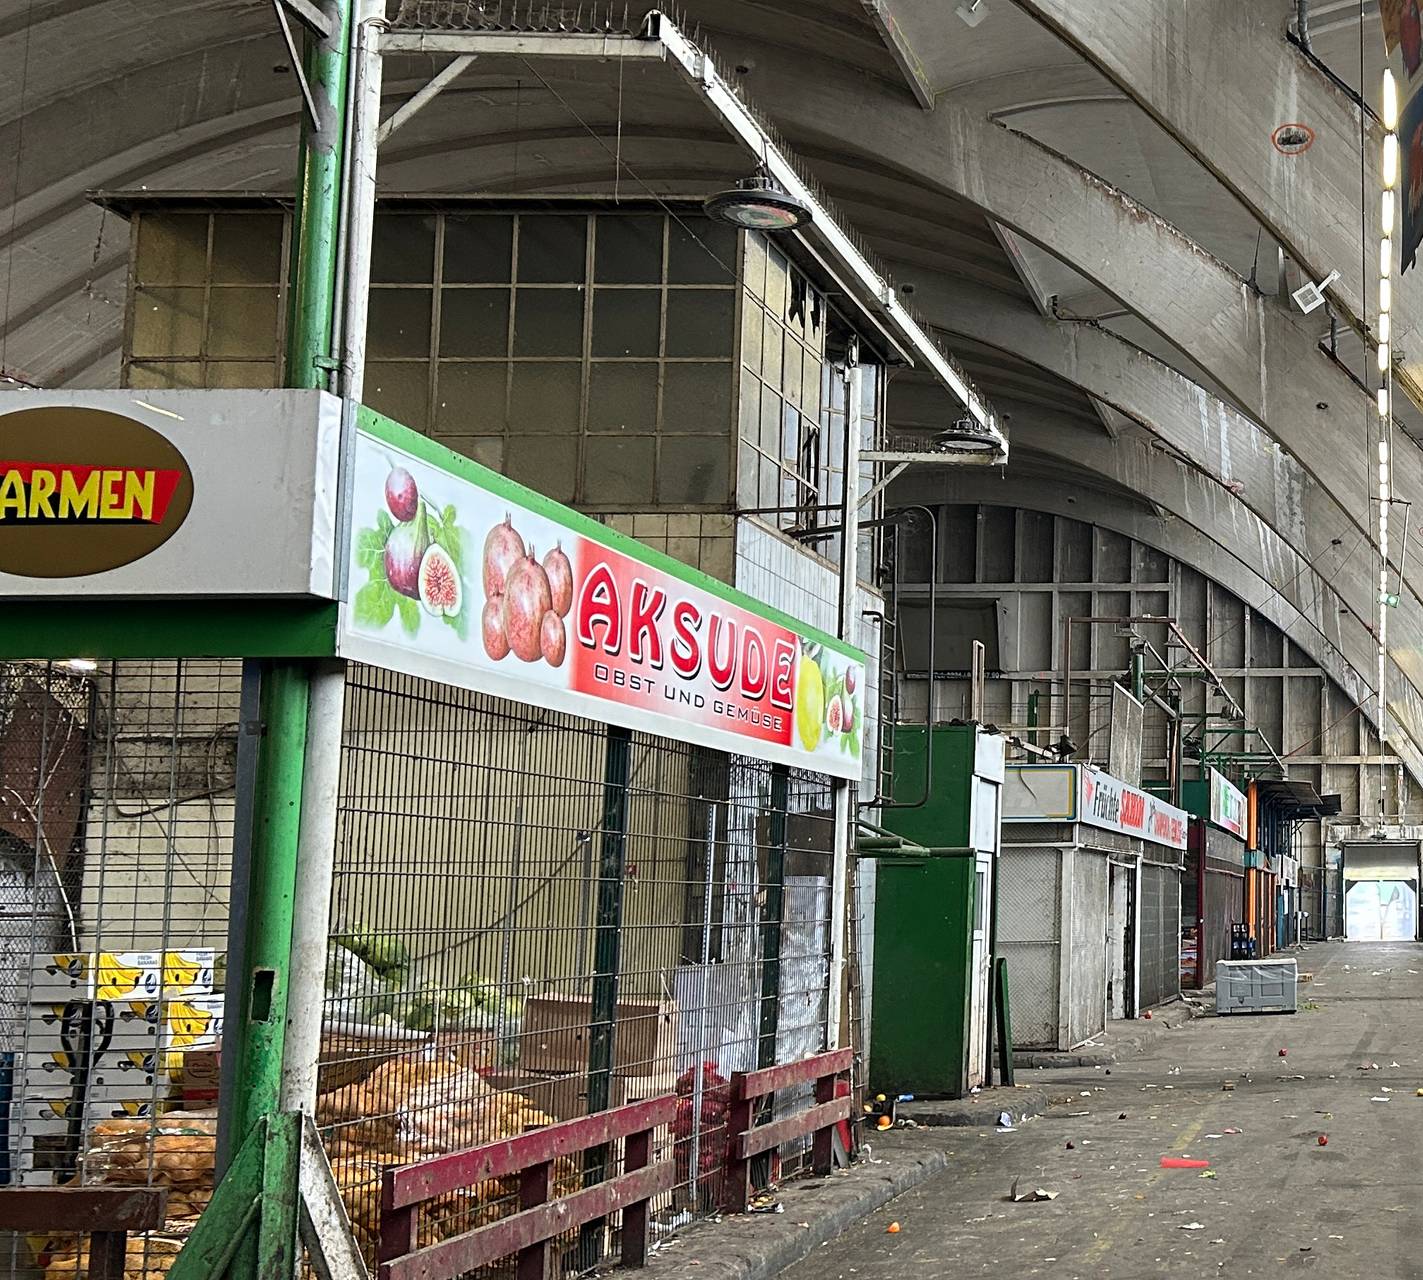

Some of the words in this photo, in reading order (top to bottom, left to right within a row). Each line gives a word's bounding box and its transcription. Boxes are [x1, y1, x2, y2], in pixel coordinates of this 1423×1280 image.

[577, 561, 796, 712] AKSUDE
[594, 664, 656, 694] OBST
[664, 684, 705, 709] UND
[713, 700, 783, 731] GEMÜSE
[1093, 781, 1119, 824] Früchte
